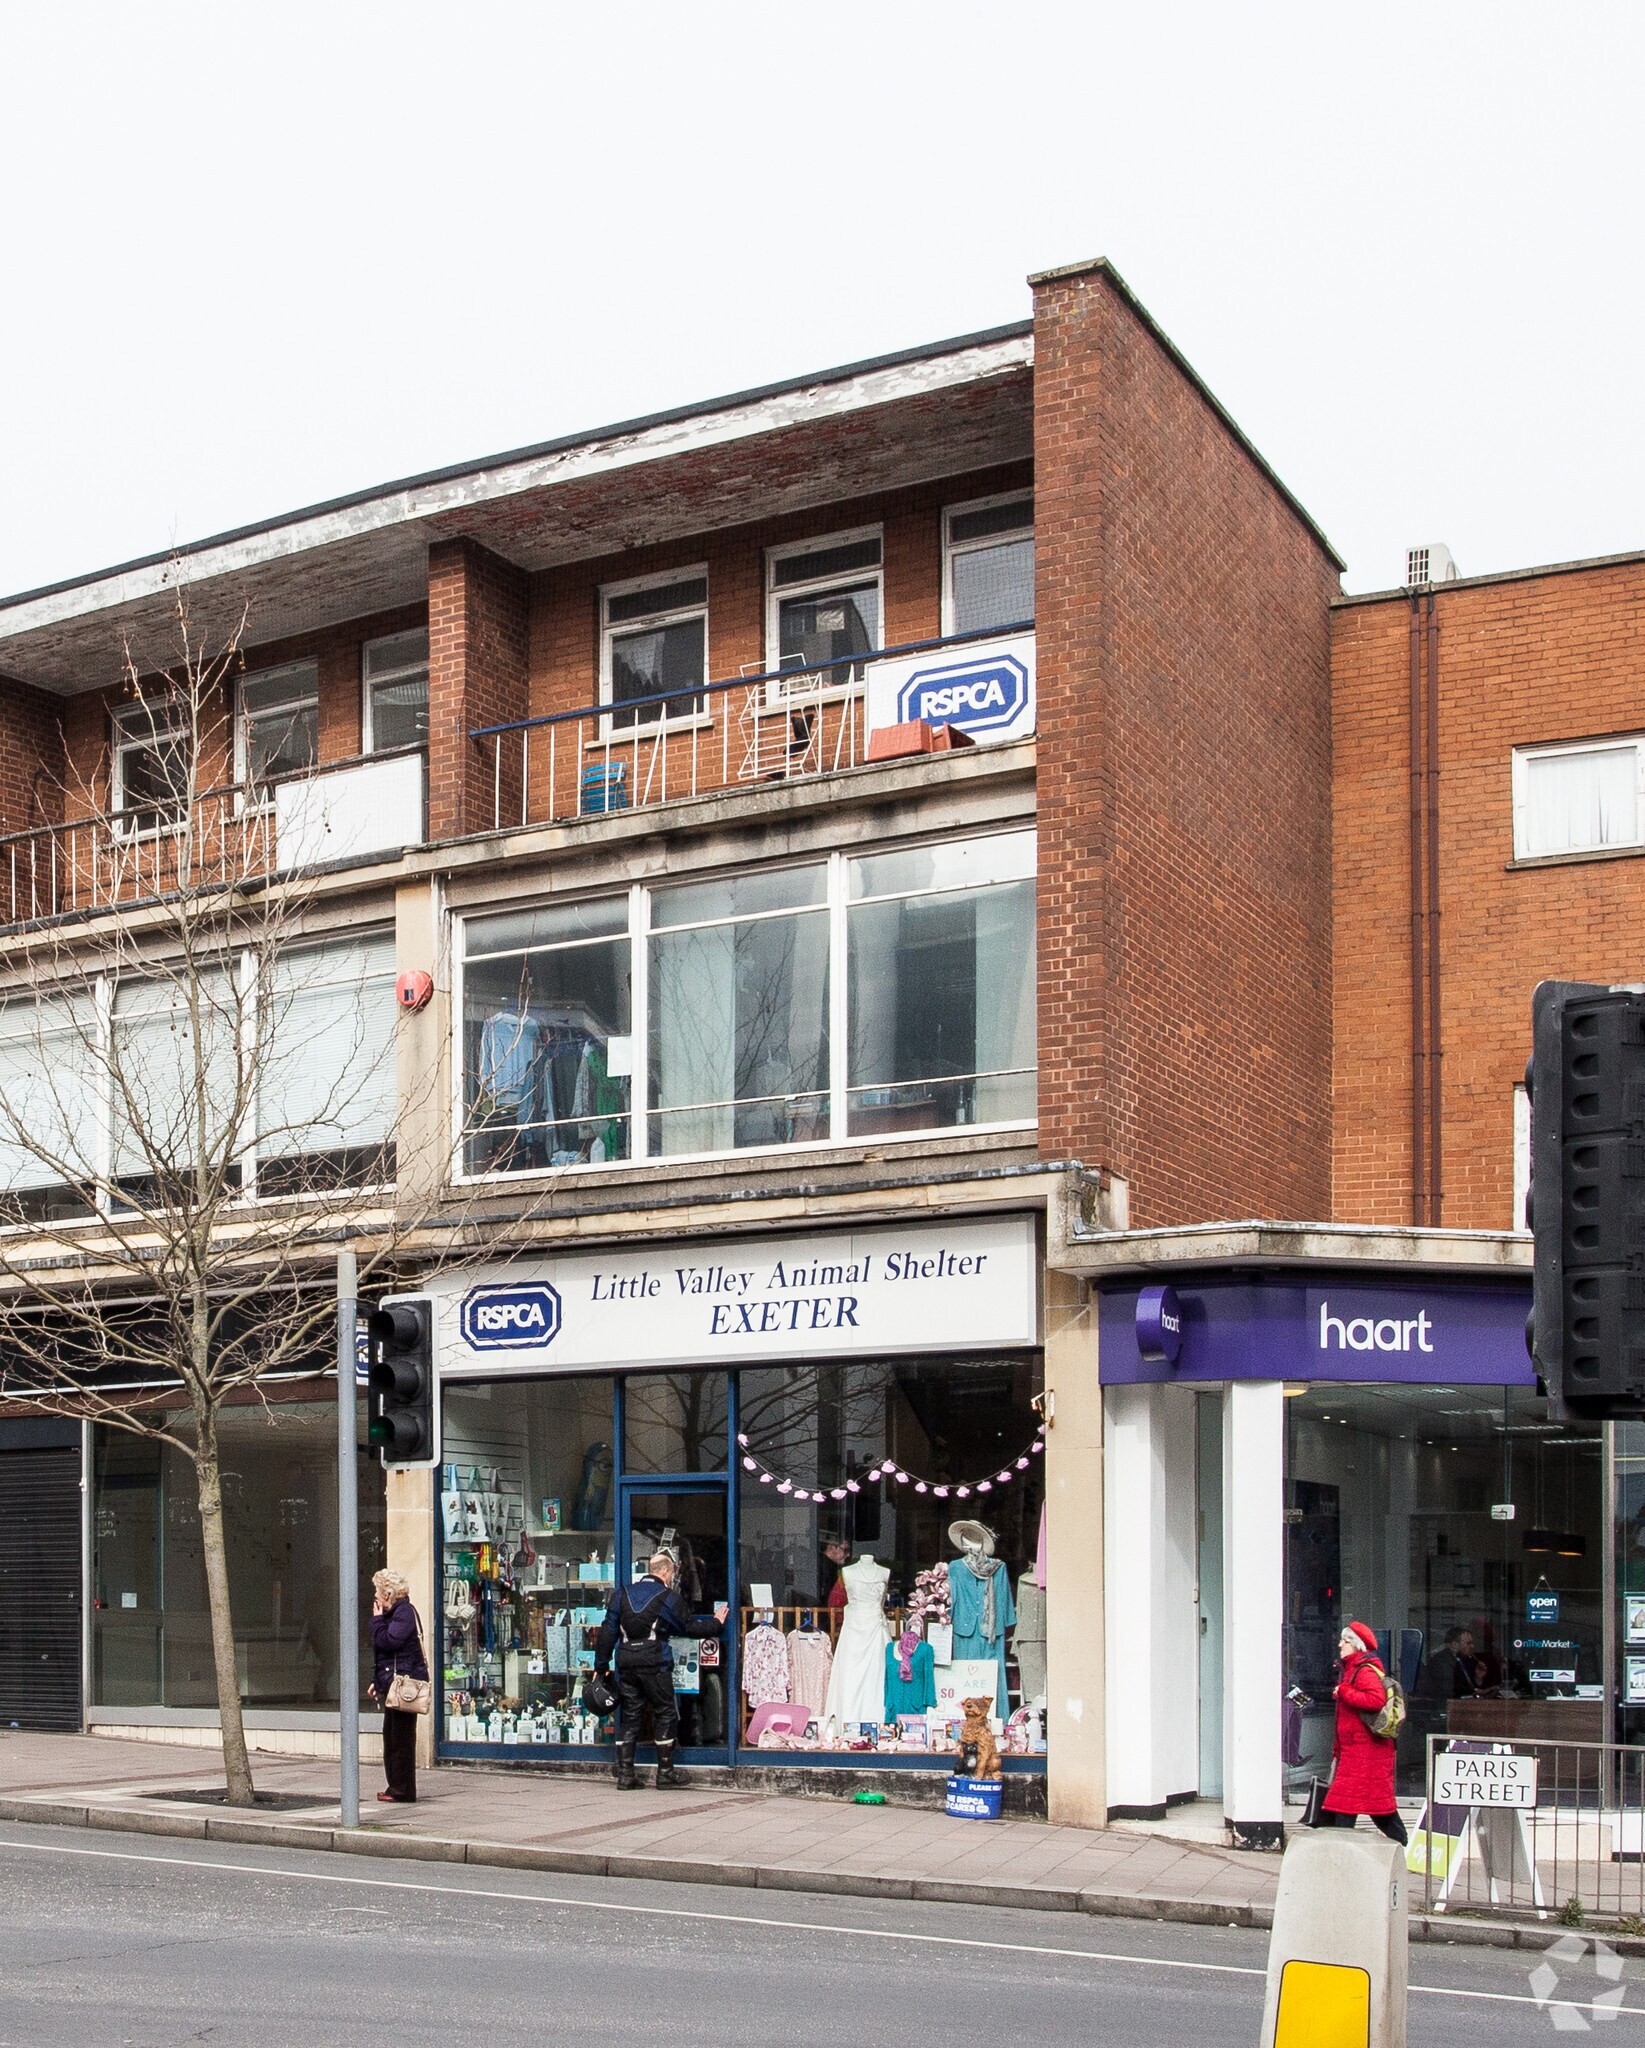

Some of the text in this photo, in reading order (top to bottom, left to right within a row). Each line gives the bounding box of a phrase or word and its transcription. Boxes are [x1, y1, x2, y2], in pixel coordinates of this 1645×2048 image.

[920, 679, 1006, 719] RSPCA
[591, 1248, 988, 1301] Little Valley Animal Shelter
[477, 1302, 546, 1330] RSPCA
[708, 1296, 860, 1336] EXETER
[1161, 1307, 1180, 1333] haart
[1320, 1301, 1434, 1353] haart
[1529, 1597, 1557, 1608] open
[940, 1687, 955, 1699] SO
[963, 1679, 987, 1689] ARE
[1455, 1759, 1518, 1779] PARIS
[1440, 1781, 1530, 1802] STREET
